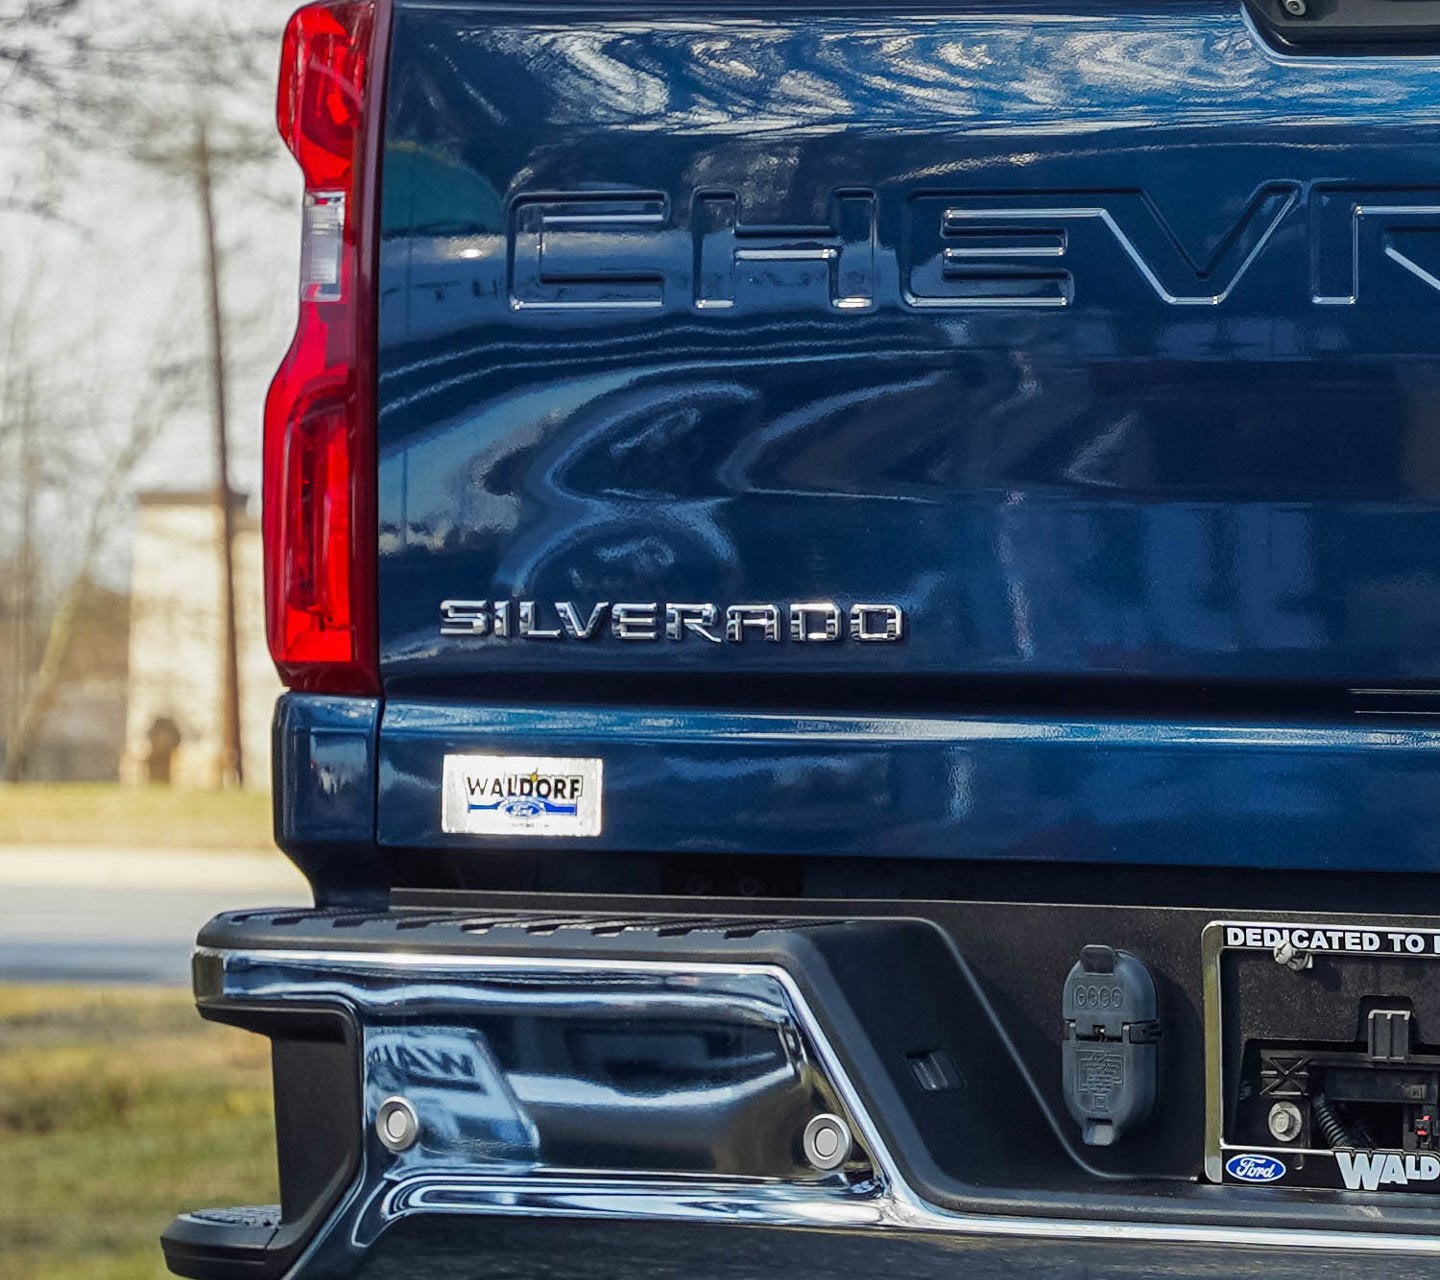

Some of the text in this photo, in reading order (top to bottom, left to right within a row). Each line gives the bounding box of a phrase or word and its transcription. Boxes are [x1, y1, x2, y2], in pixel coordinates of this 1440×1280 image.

[439, 599, 904, 644] SILVERADO
[466, 775, 581, 800] WALDORF
[1226, 927, 1380, 952] DEDICATED
[1387, 932, 1425, 953] TO
[1236, 1156, 1276, 1181] Ford
